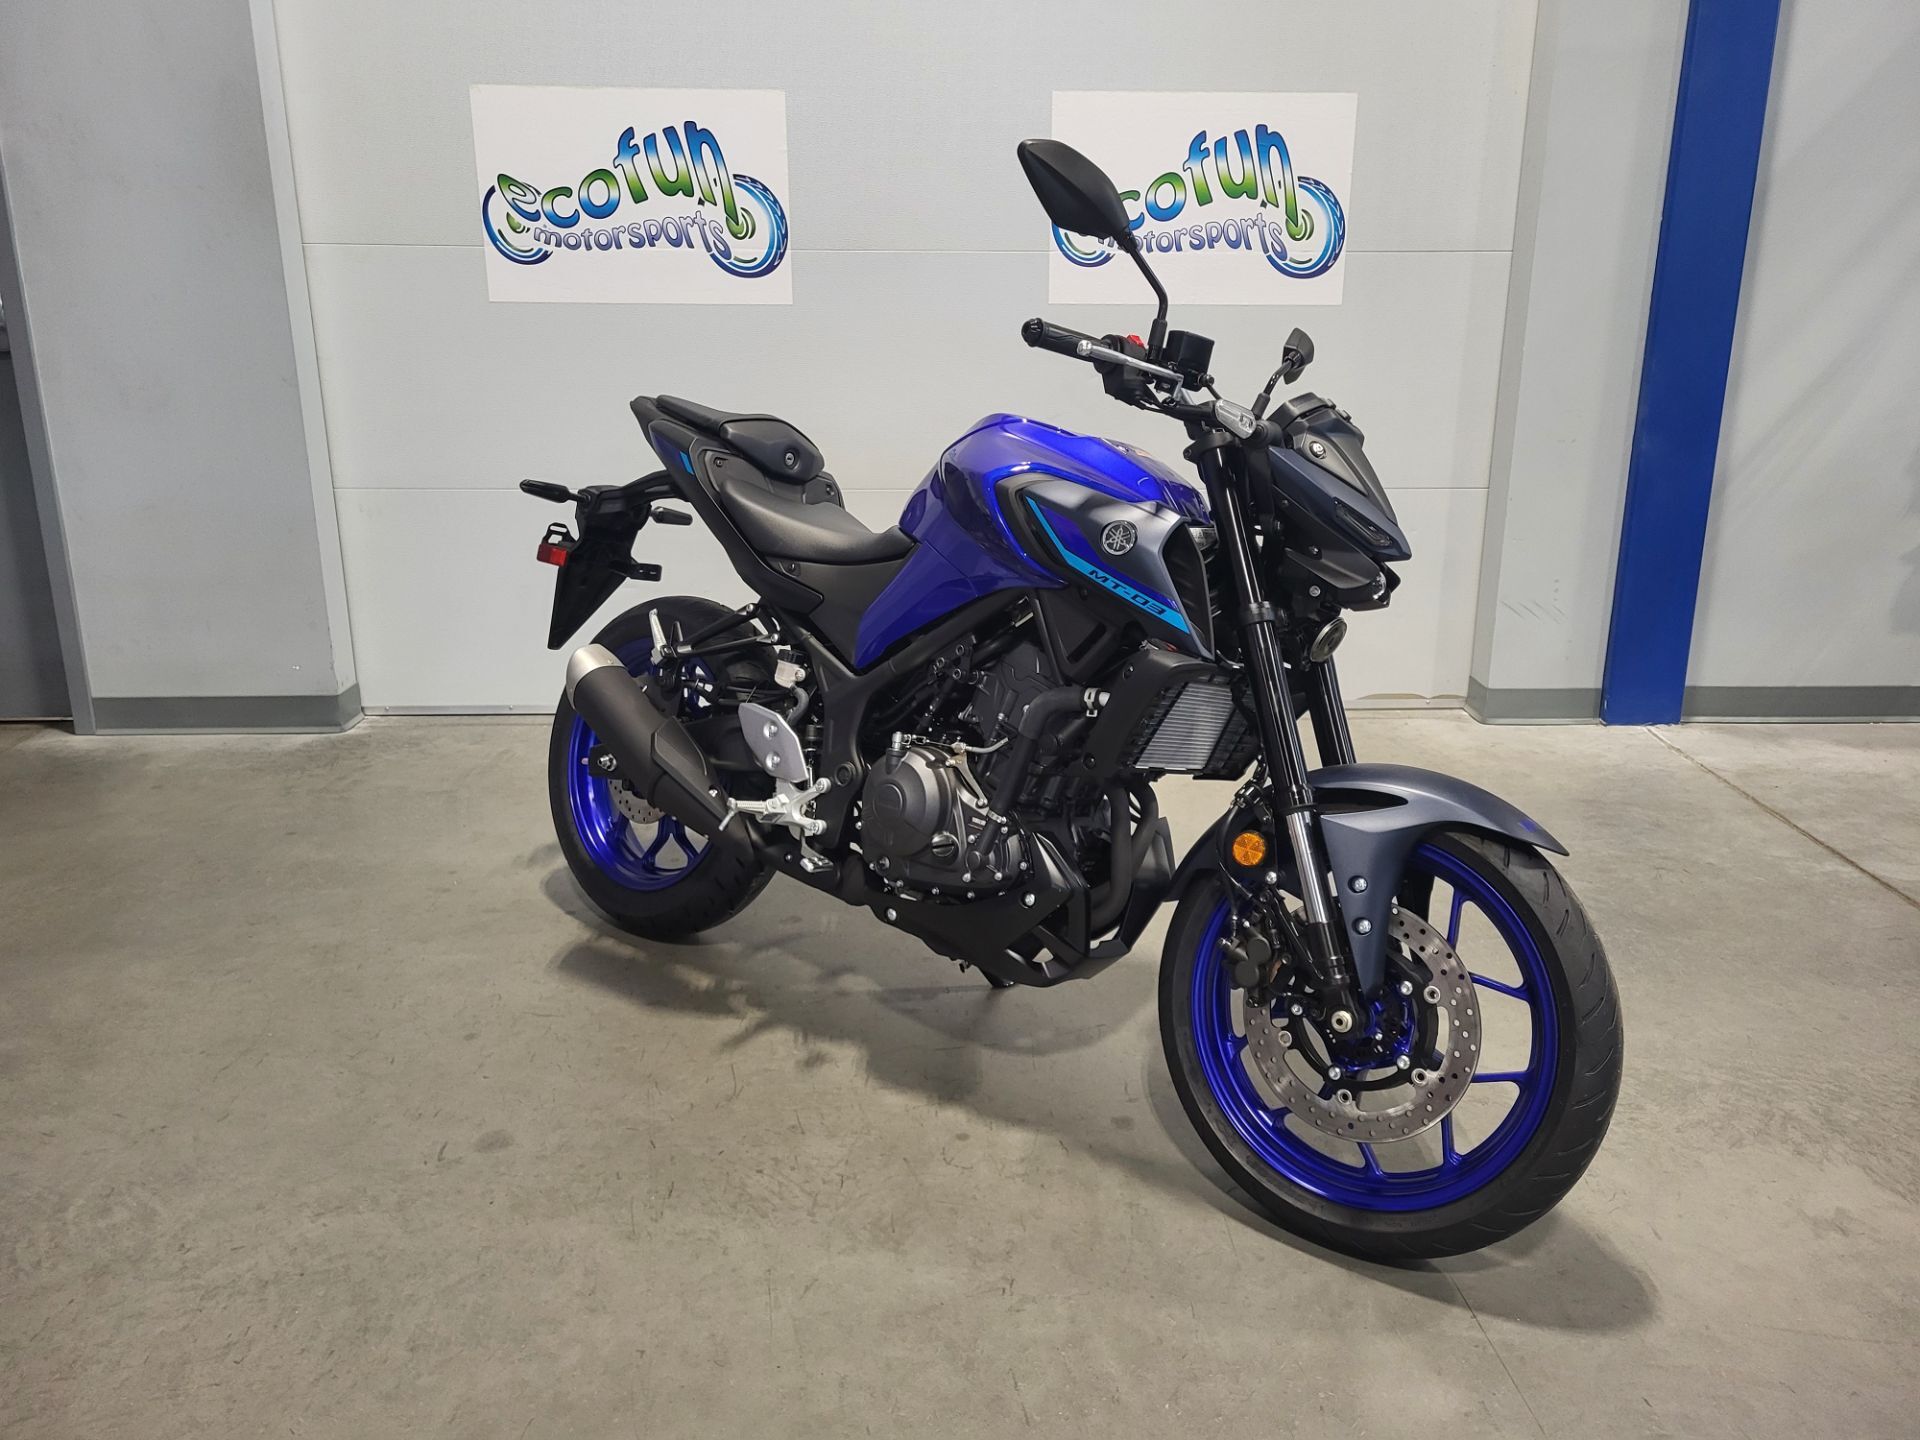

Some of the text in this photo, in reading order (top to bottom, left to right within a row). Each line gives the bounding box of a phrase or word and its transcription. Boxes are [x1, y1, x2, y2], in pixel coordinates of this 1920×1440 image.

[497, 120, 739, 228] ecofun
[1118, 124, 1299, 231] cofun
[533, 210, 732, 260] motorsports
[1088, 569, 1167, 615] MT-03
